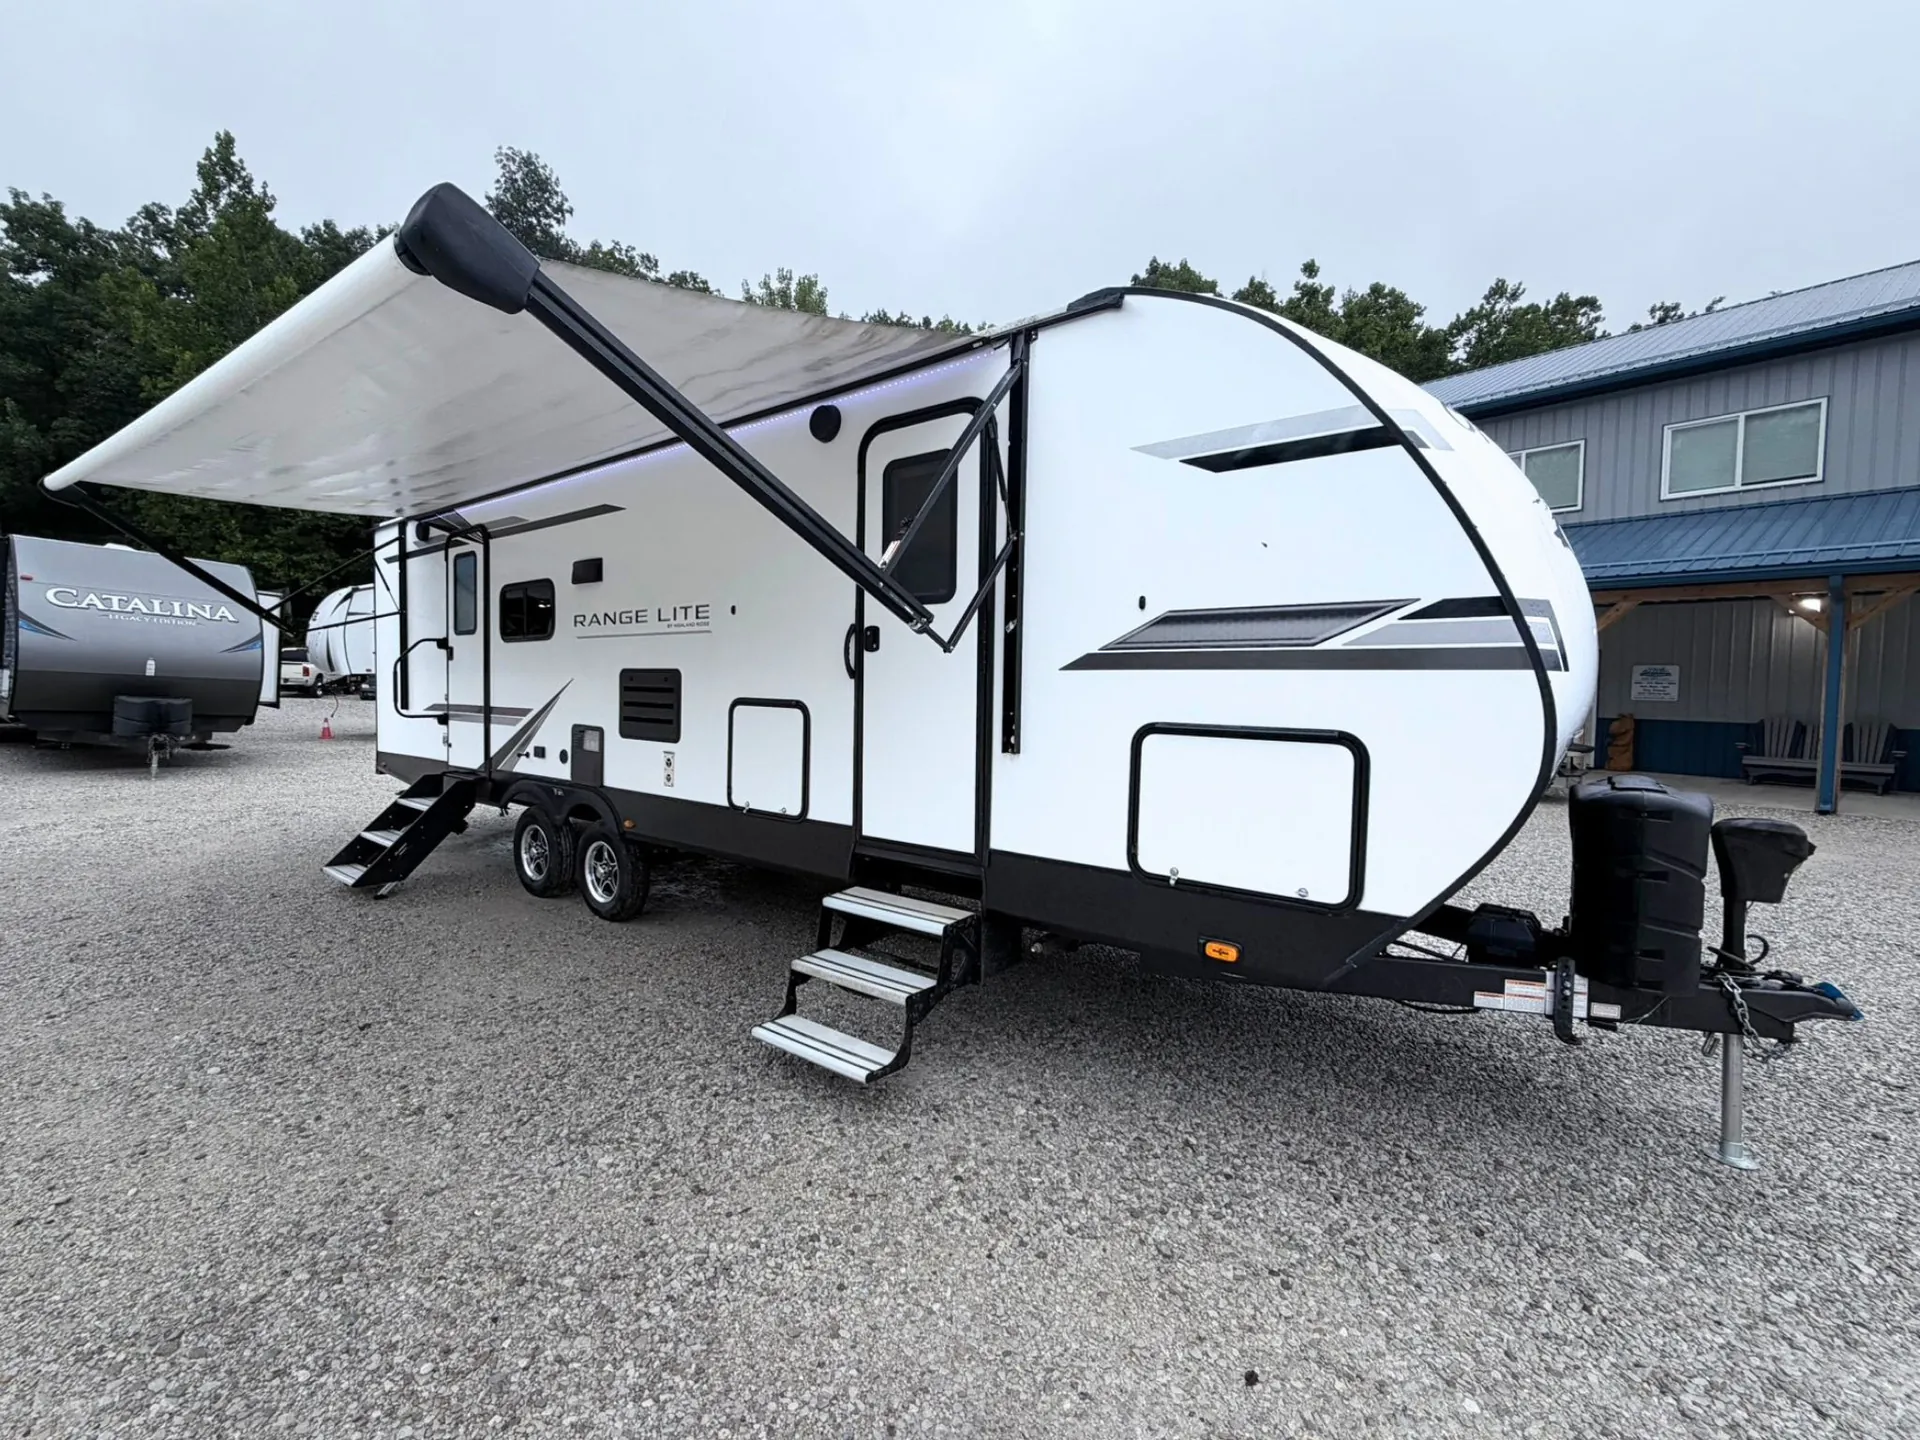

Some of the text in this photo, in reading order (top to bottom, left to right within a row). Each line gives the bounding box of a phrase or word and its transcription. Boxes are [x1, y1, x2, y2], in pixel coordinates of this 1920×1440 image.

[45, 588, 239, 622] CATALINA
[573, 604, 710, 627] RANGE LITE
